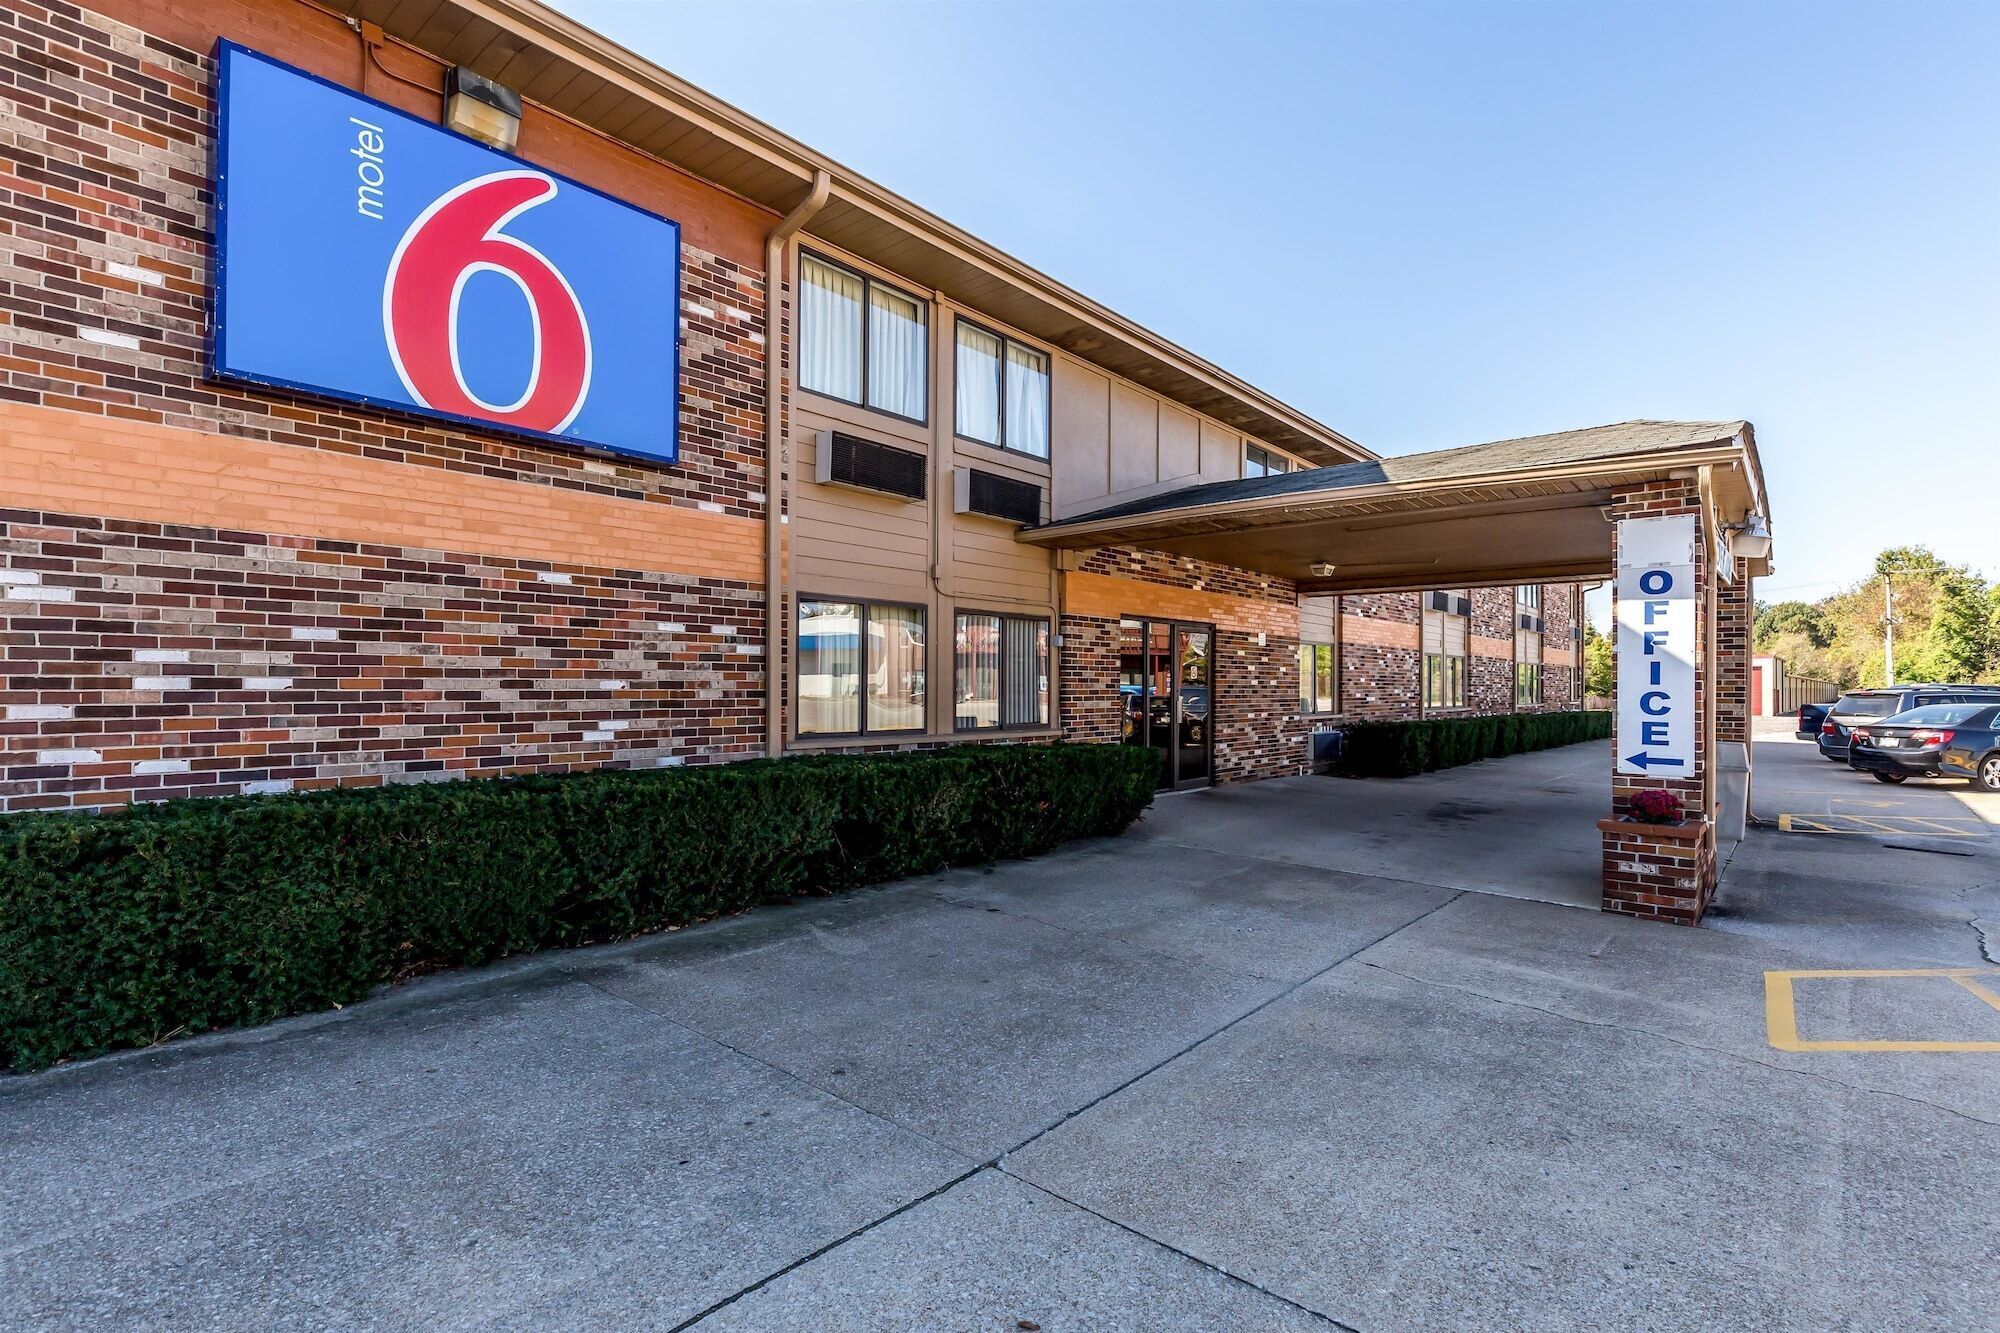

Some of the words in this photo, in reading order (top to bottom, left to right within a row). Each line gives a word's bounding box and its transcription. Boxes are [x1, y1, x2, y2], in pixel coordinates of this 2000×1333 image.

[349, 116, 385, 221] motel
[382, 169, 593, 435] 6
[1639, 570, 1674, 746] OFFICE
